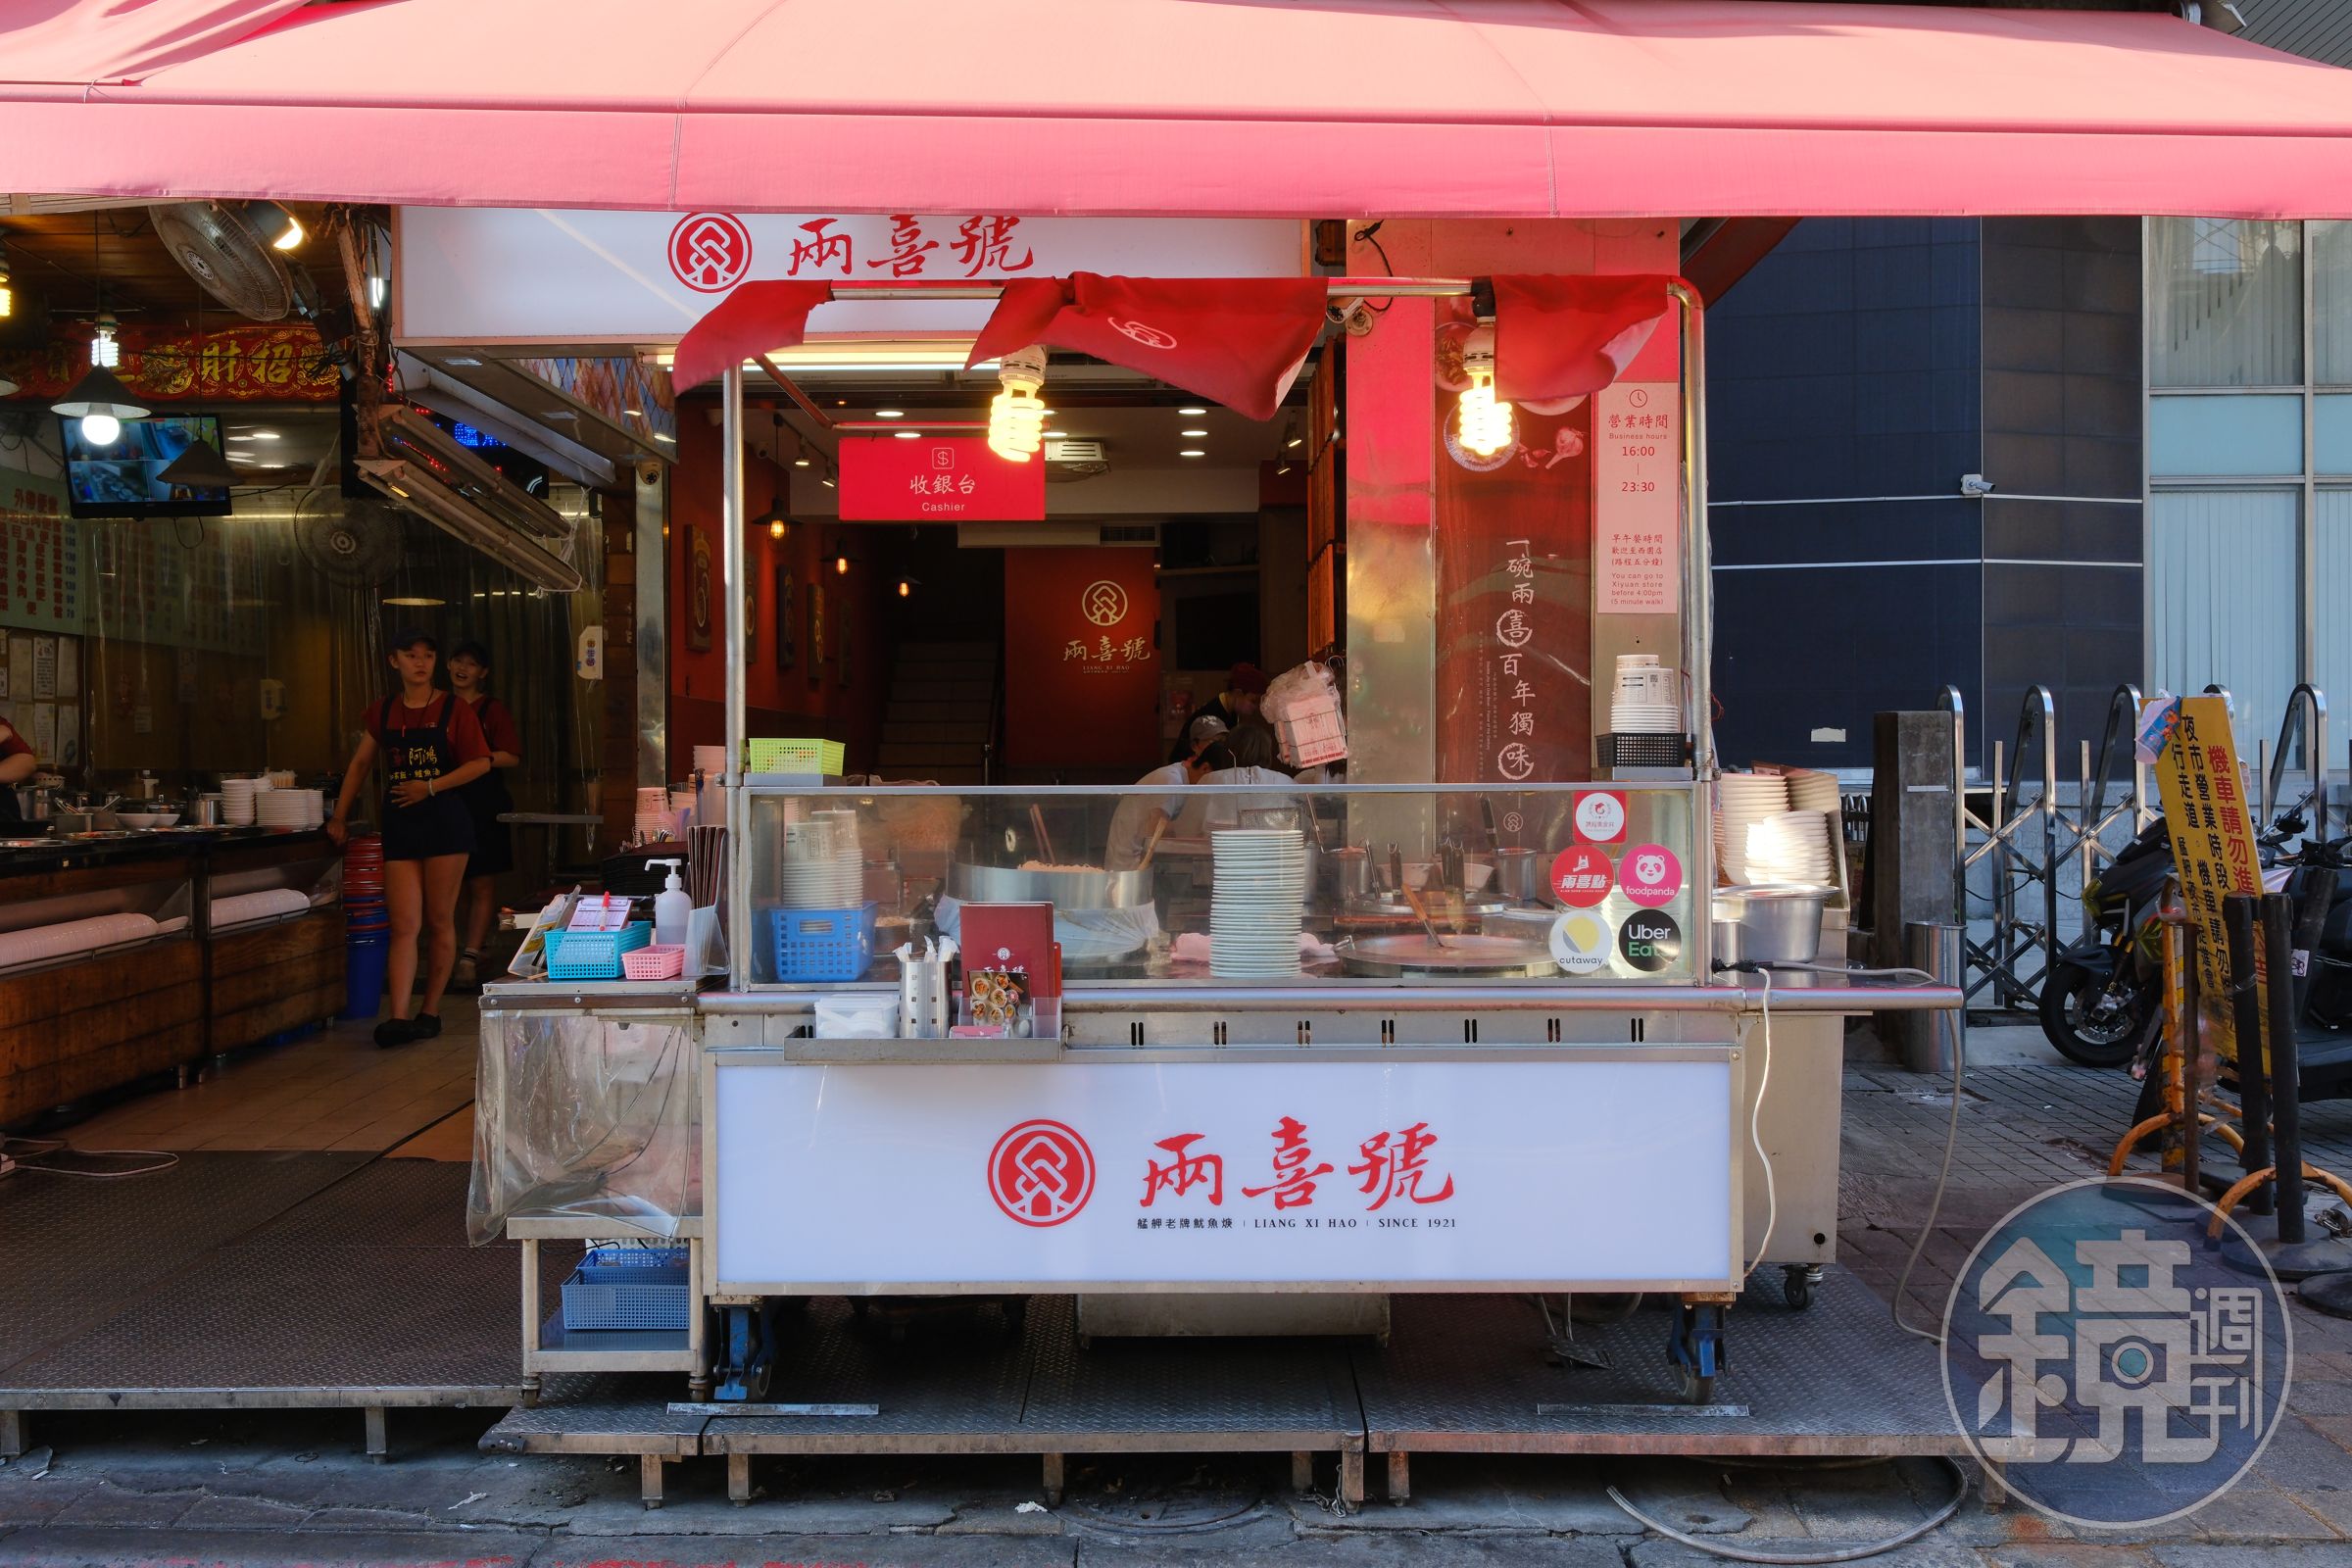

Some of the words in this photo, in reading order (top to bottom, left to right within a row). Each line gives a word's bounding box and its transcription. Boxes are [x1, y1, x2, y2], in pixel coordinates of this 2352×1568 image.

[787, 215, 1034, 278] 兩喜號
[1608, 414, 1668, 429] 營業時間
[1622, 446, 1655, 457] 16:00
[909, 473, 976, 495] 收銀台
[1622, 481, 1655, 493] 23:30
[921, 502, 965, 512] Cashier
[1611, 533, 1663, 544] 早午餐時間
[1062, 635, 1152, 662] 兩喜號
[1496, 538, 1536, 781] 一碗兩喜百年獨味
[2169, 729, 2200, 829] 行走道
[2181, 714, 2230, 891] 夜市營業時段
[1626, 886, 1676, 898] foodpanda
[1628, 924, 1671, 940] Uber
[1559, 956, 1603, 967] cutaway
[1139, 1115, 1454, 1211] 兩喜號
[1254, 1218, 1297, 1228] LIANG
[1305, 1218, 1319, 1228] XI
[1328, 1218, 1357, 1228] HAO
[1379, 1218, 1419, 1228] SINCE
[1428, 1218, 1456, 1228] 1921
